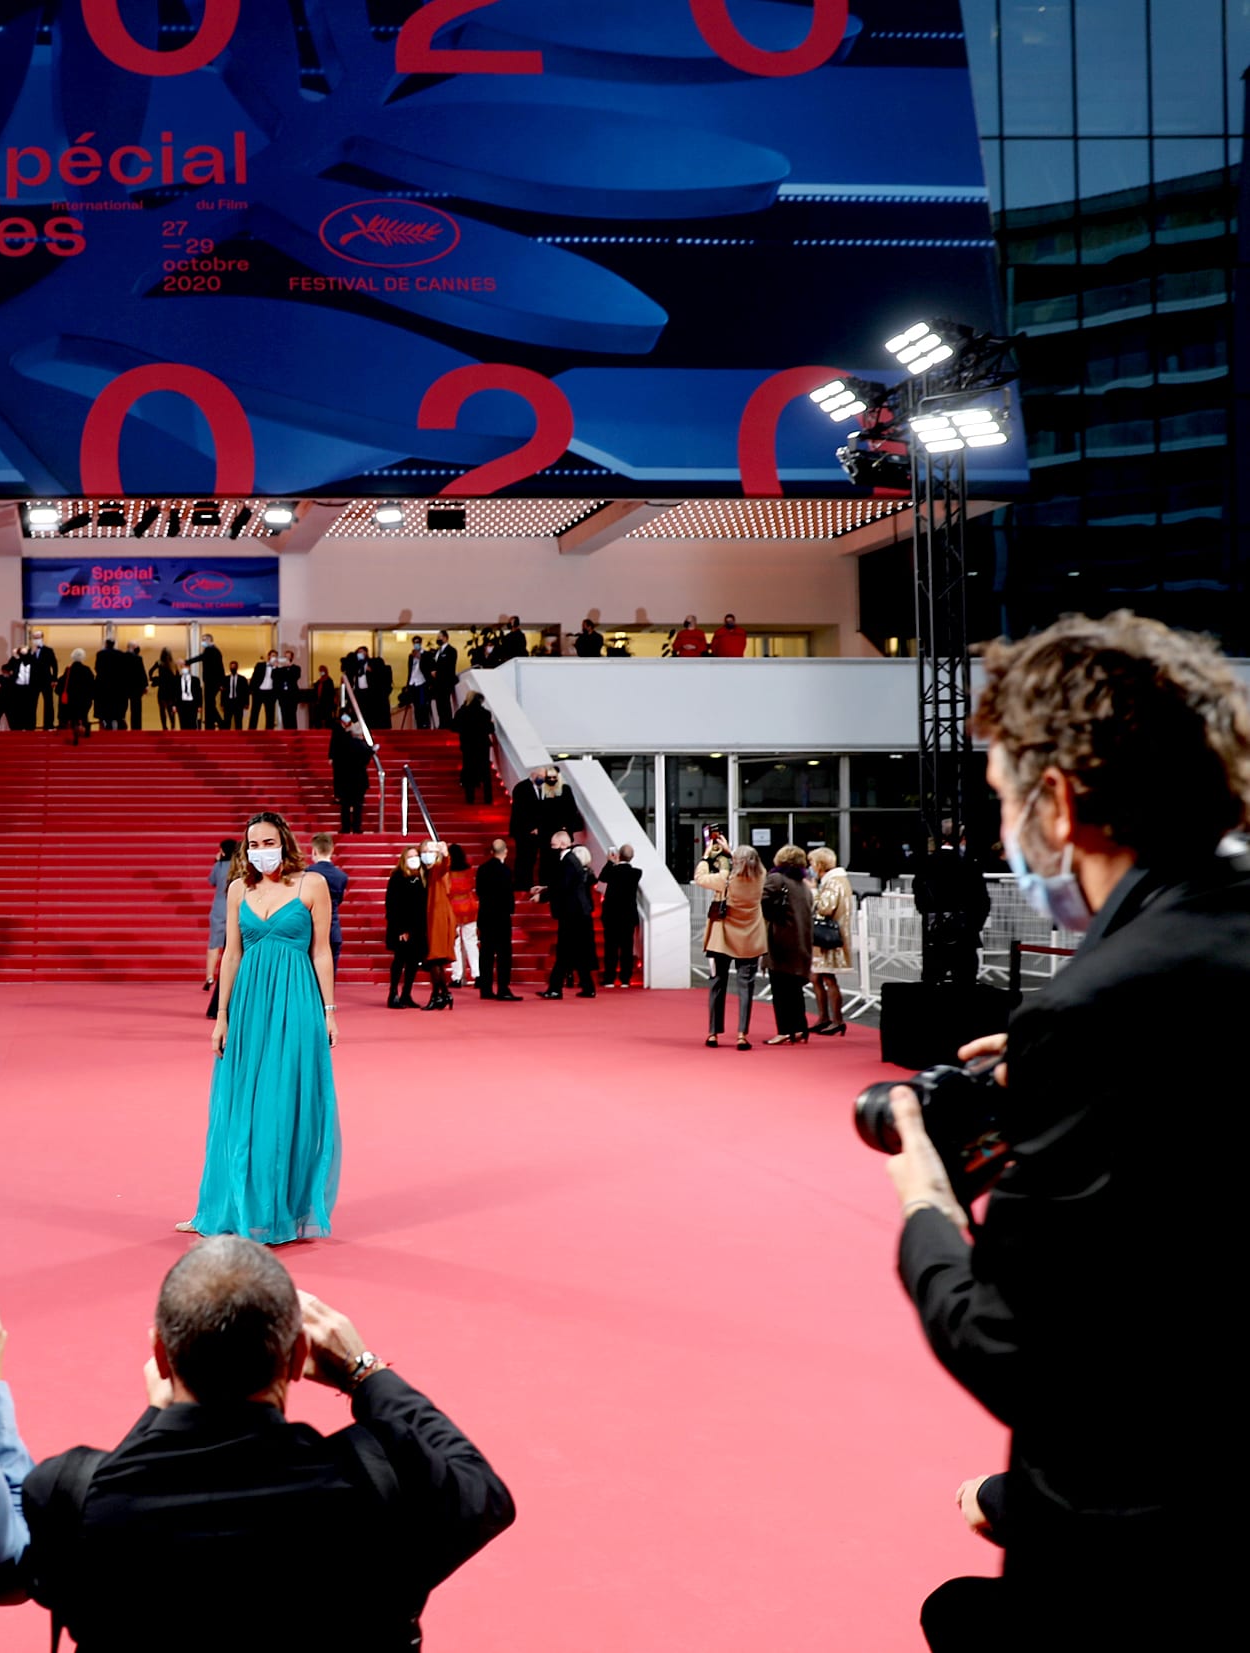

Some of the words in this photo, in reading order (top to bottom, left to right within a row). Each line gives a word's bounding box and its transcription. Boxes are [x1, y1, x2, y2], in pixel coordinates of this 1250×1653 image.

[51, 200, 144, 211] International
[195, 199, 215, 210] du
[218, 199, 248, 210] Film
[162, 220, 188, 237] 27
[163, 257, 249, 272] octobre
[163, 275, 221, 291] 2020
[289, 276, 379, 291] FESTIVAL
[384, 277, 409, 291] DE
[415, 277, 496, 291] CANNES
[91, 566, 153, 582] Spécial
[58, 582, 121, 596] Cannes
[91, 595, 133, 609] 2020
